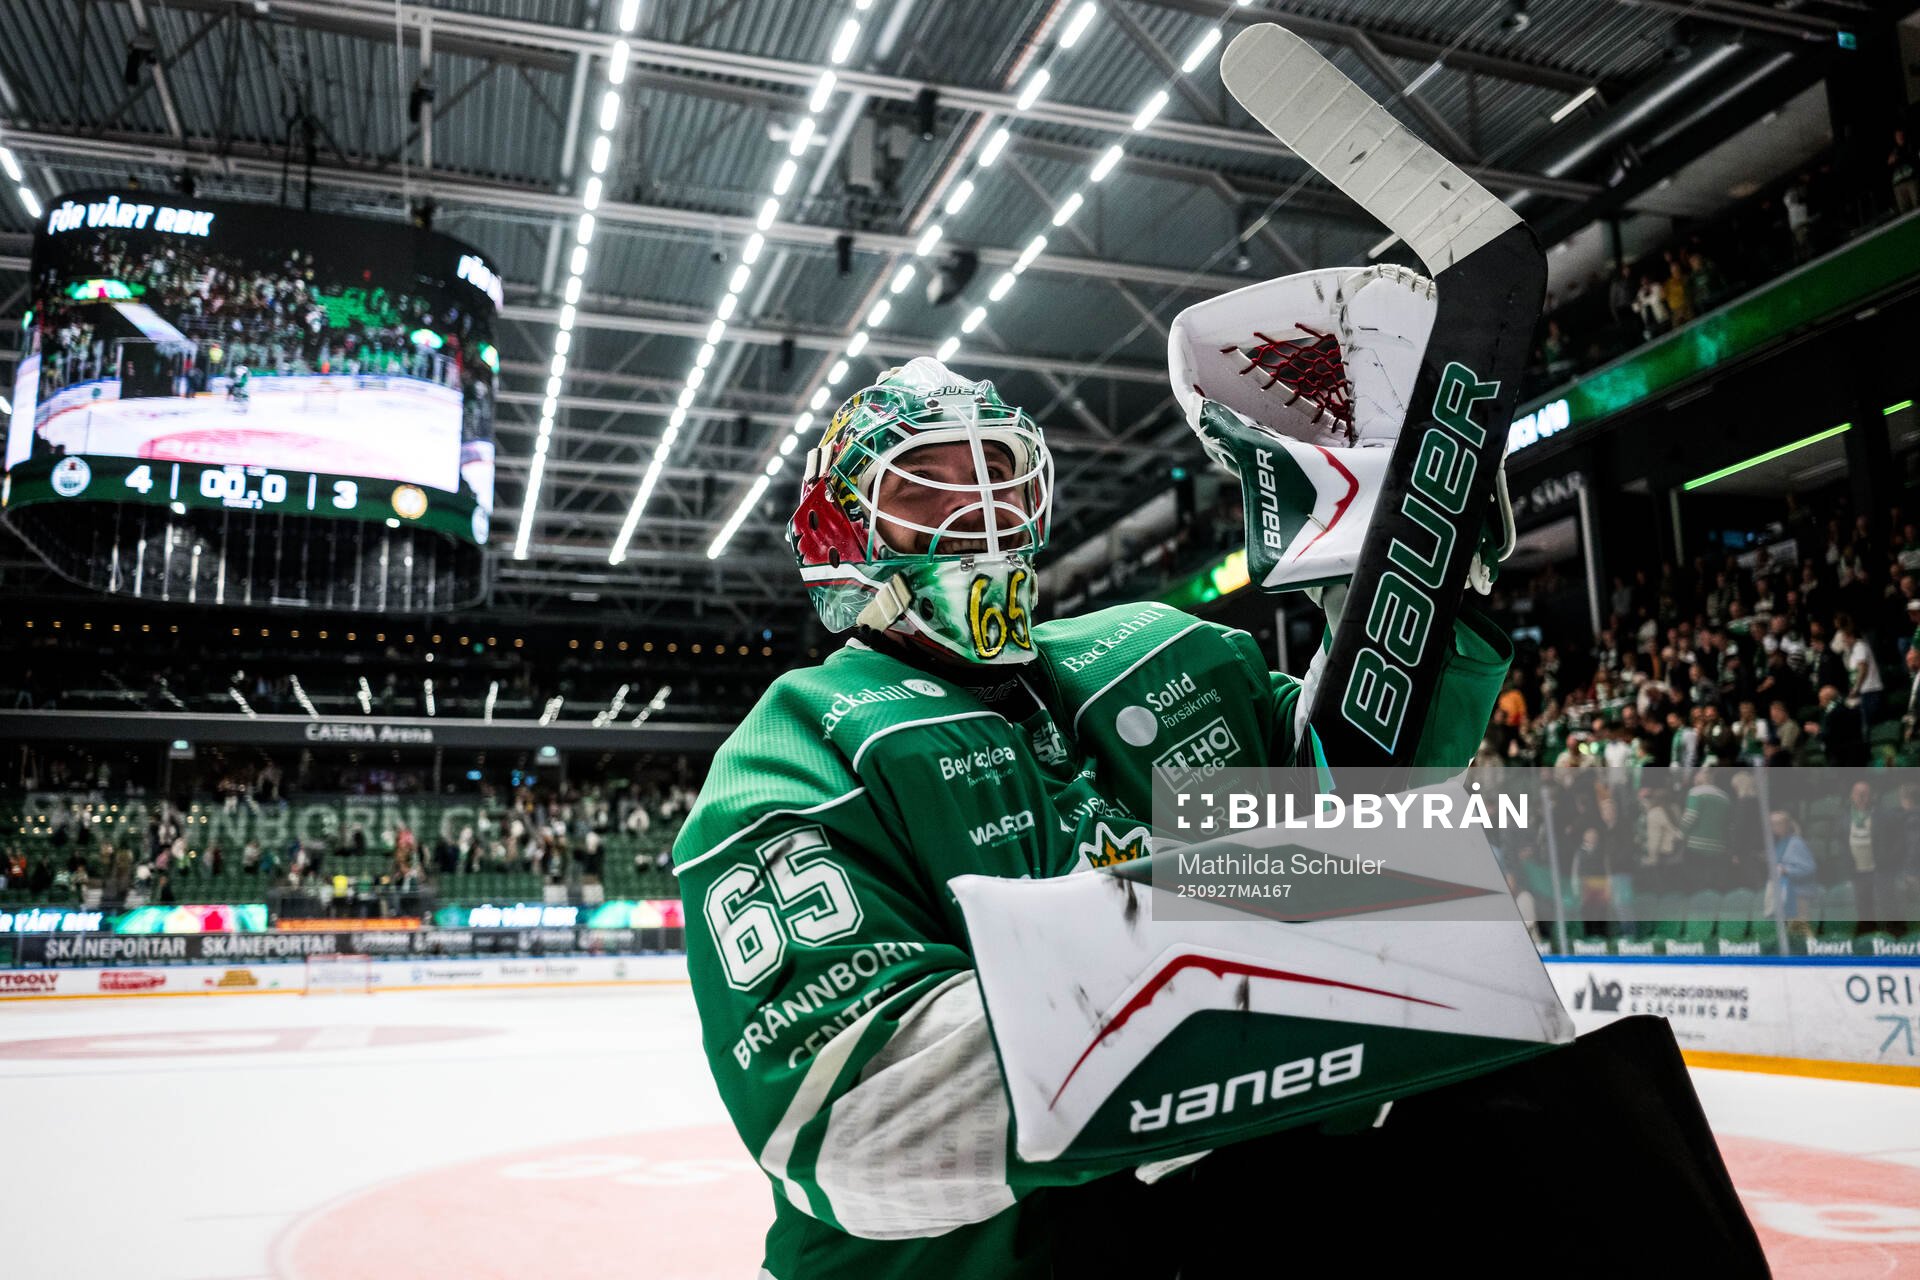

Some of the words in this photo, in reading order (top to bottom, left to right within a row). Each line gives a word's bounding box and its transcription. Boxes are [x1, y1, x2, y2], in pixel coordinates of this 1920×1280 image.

[48, 201, 86, 236] FÖR
[87, 195, 155, 230] VÅRT
[125, 465, 153, 494] 4
[200, 470, 287, 503] 00.0
[332, 480, 358, 510] 3
[1256, 448, 1282, 549] BAUER
[1341, 361, 1501, 756] BAUER
[966, 568, 1032, 661] 65
[1060, 608, 1167, 673] Backahill
[820, 684, 918, 741] ackahill
[1146, 672, 1197, 712] Solid
[1160, 688, 1222, 729] Försäkring
[305, 722, 376, 741] CATENA
[378, 724, 434, 743] Arena
[1191, 757, 1227, 785] YGG
[703, 824, 865, 992] 65
[45, 931, 187, 958] SKÅNEPORTAR
[201, 929, 336, 957] SKÅNEPORTAR
[1845, 974, 1920, 1004] ORI
[1130, 1043, 1365, 1134] BAUER
